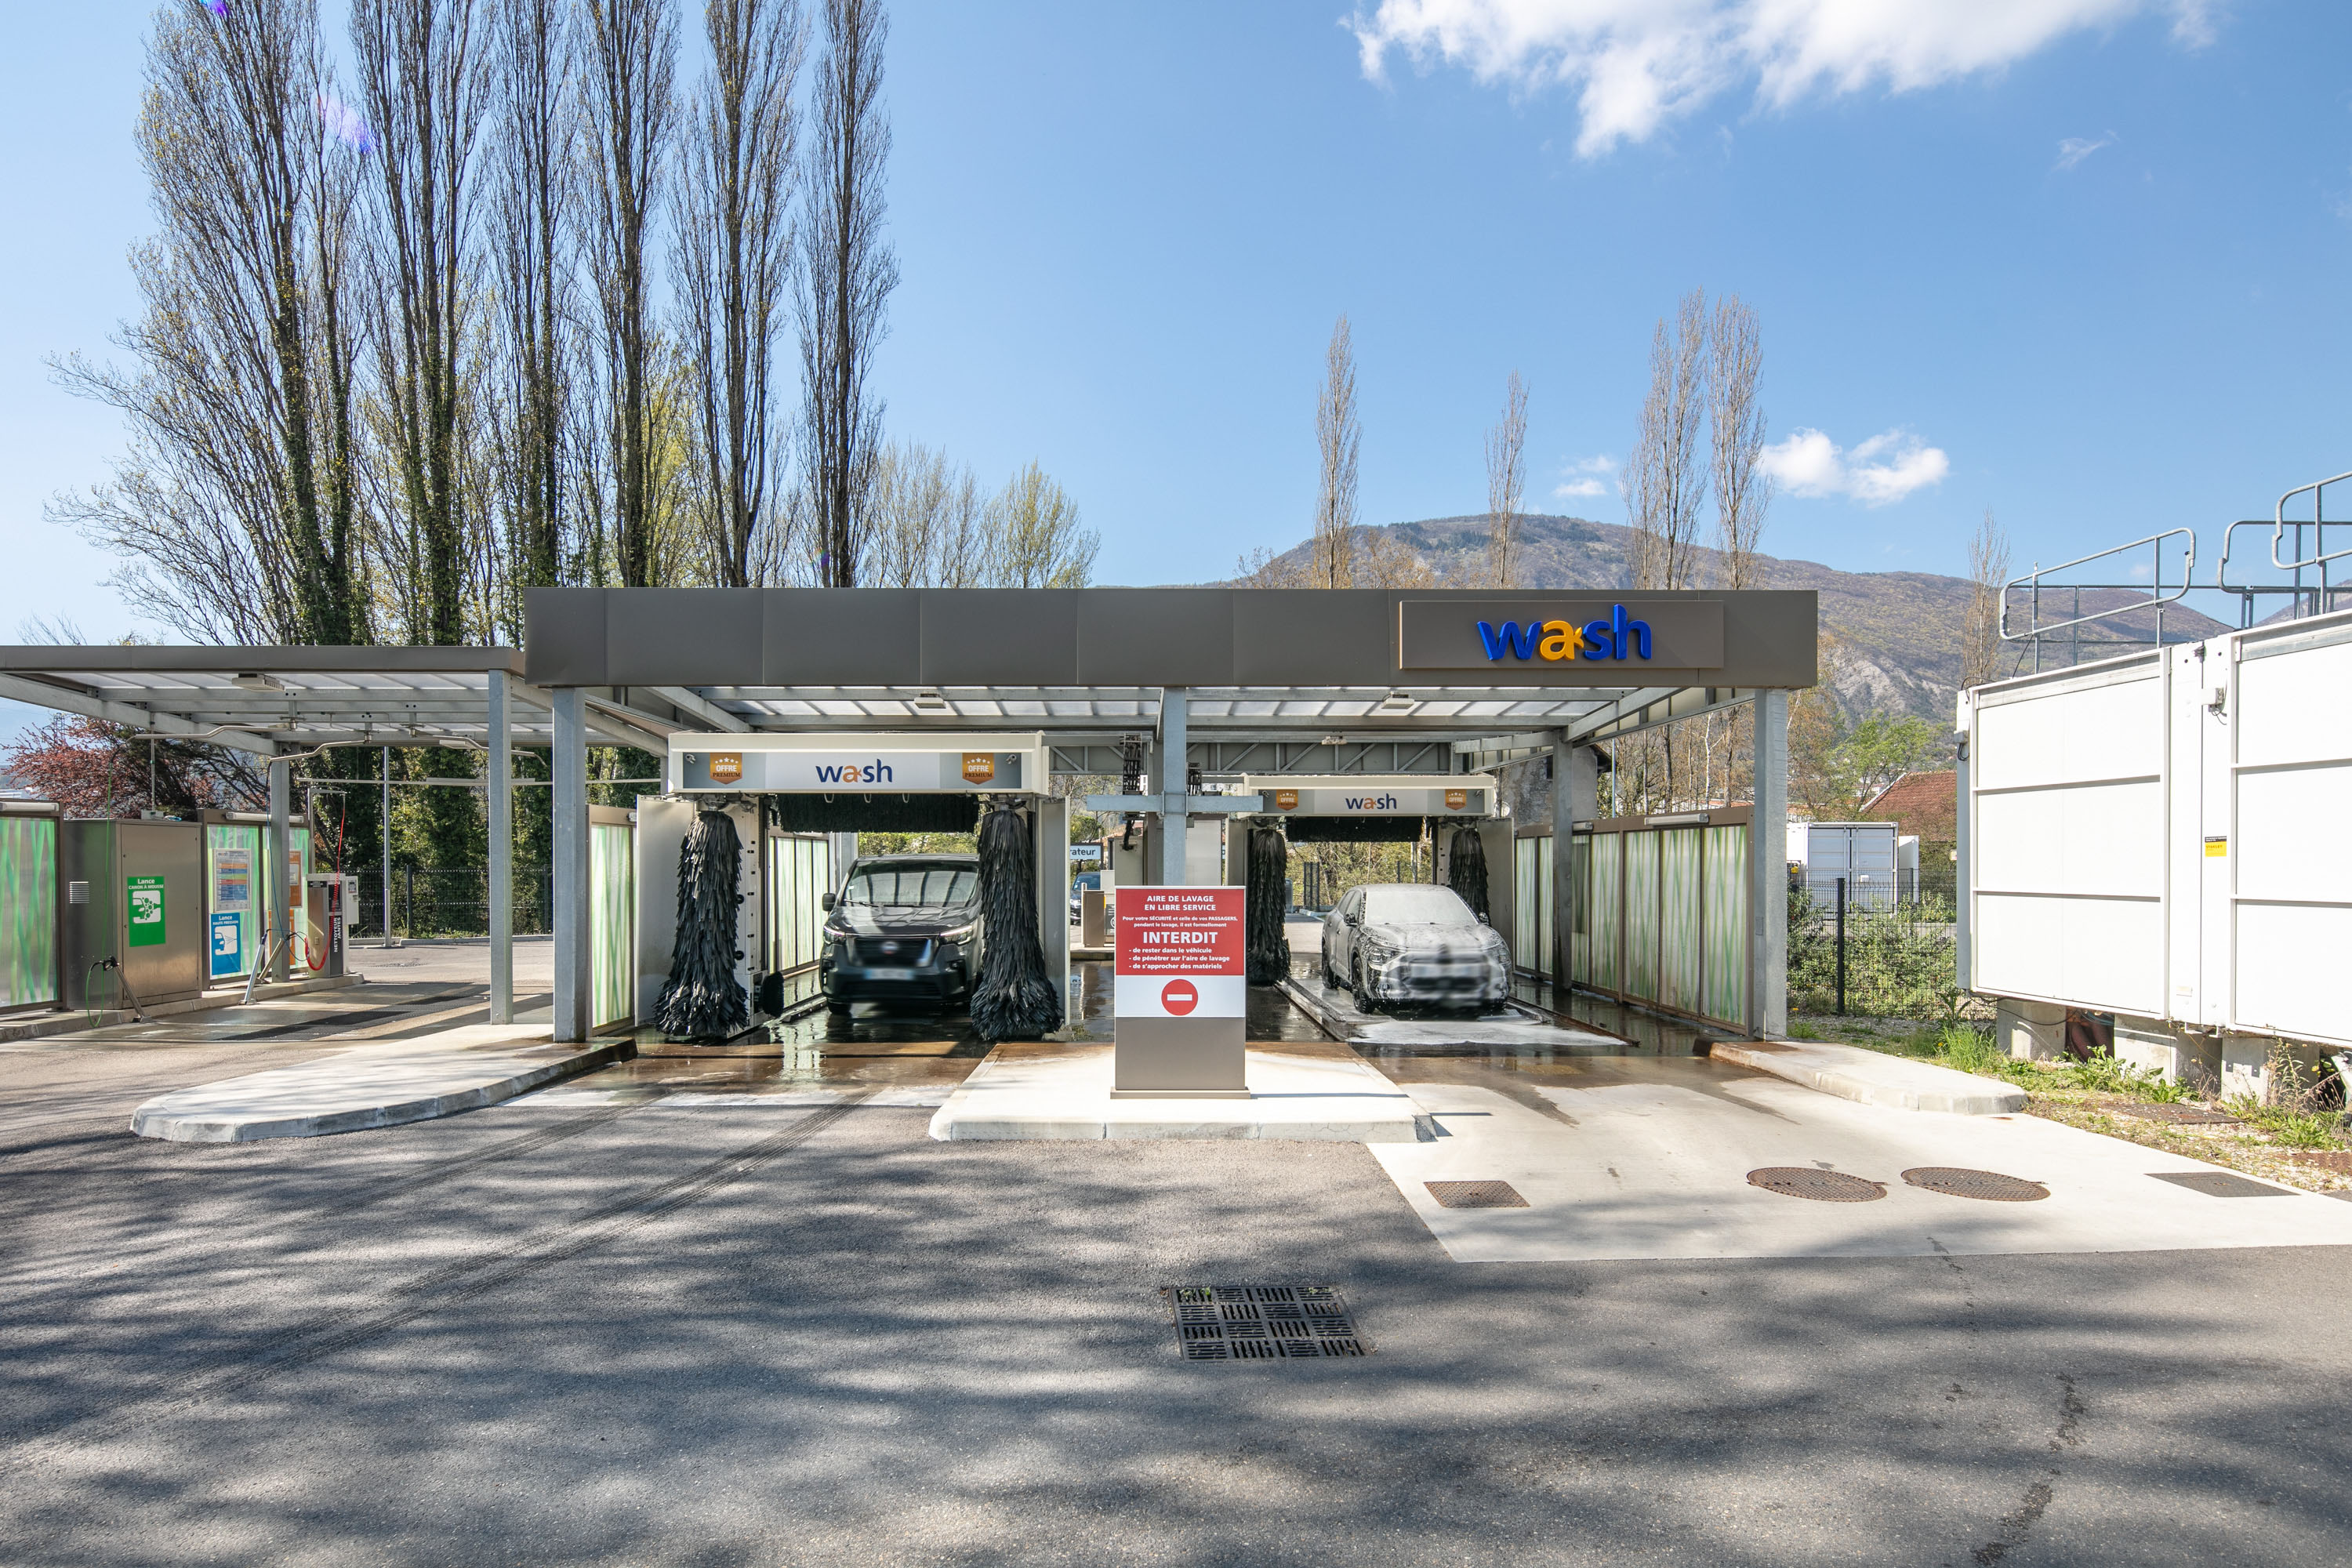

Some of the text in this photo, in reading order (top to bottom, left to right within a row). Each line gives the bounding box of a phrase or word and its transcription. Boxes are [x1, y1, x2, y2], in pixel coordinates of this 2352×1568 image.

[1476, 604, 1652, 661] wash
[815, 758, 892, 783] wash
[1345, 793, 1397, 810] wash
[1143, 931, 1218, 944] INTERDIT
